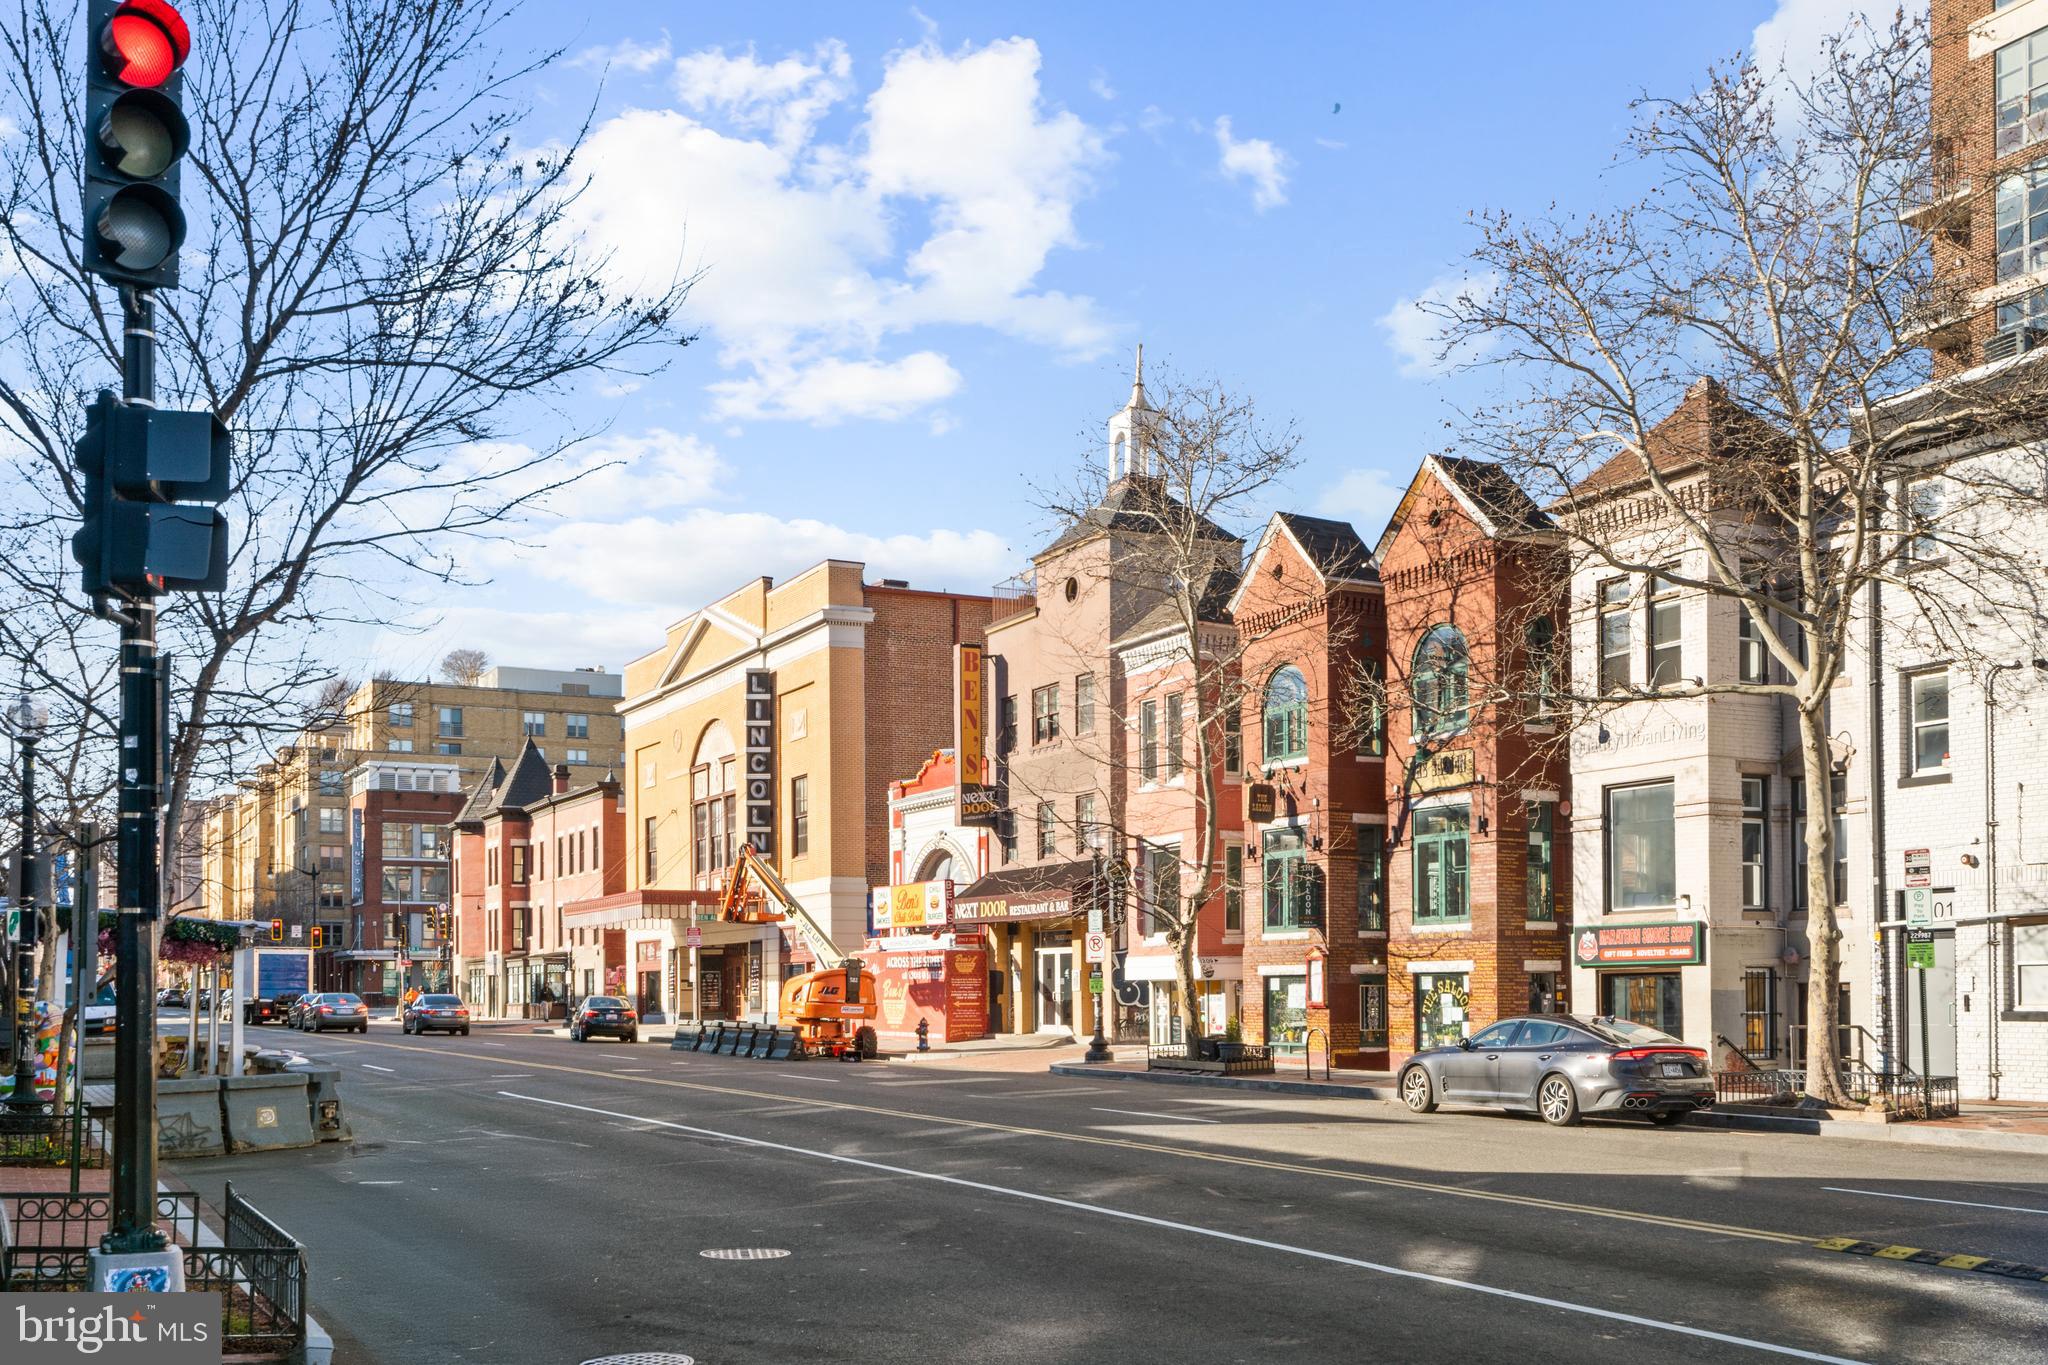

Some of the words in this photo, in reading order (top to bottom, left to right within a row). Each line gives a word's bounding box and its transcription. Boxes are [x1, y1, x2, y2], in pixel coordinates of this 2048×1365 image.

[963, 651, 979, 777] BEN'S
[751, 675, 767, 852] LINCOLN
[963, 802, 998, 815] DOO
[896, 888, 920, 911] Ben's
[980, 900, 1008, 918] DOOR
[1009, 902, 1049, 916] RESTAURANT
[1049, 902, 1055, 912] &
[1055, 900, 1070, 912] BAR
[812, 933, 825, 948] LIFT
[1599, 928, 1641, 946] MARATHON
[1642, 926, 1670, 944] SMOKE
[1671, 925, 1694, 943] SHOP
[887, 956, 909, 969] ACROSS
[910, 955, 924, 968] THE
[1604, 950, 1616, 958] GIFT
[1617, 949, 1633, 958] ITEMS
[1636, 949, 1666, 957] NOVELTIES
[1669, 948, 1690, 956] CIGARS
[818, 986, 840, 995] JLG
[1423, 987, 1438, 1014] THE
[1437, 979, 1471, 1014] SALOON
